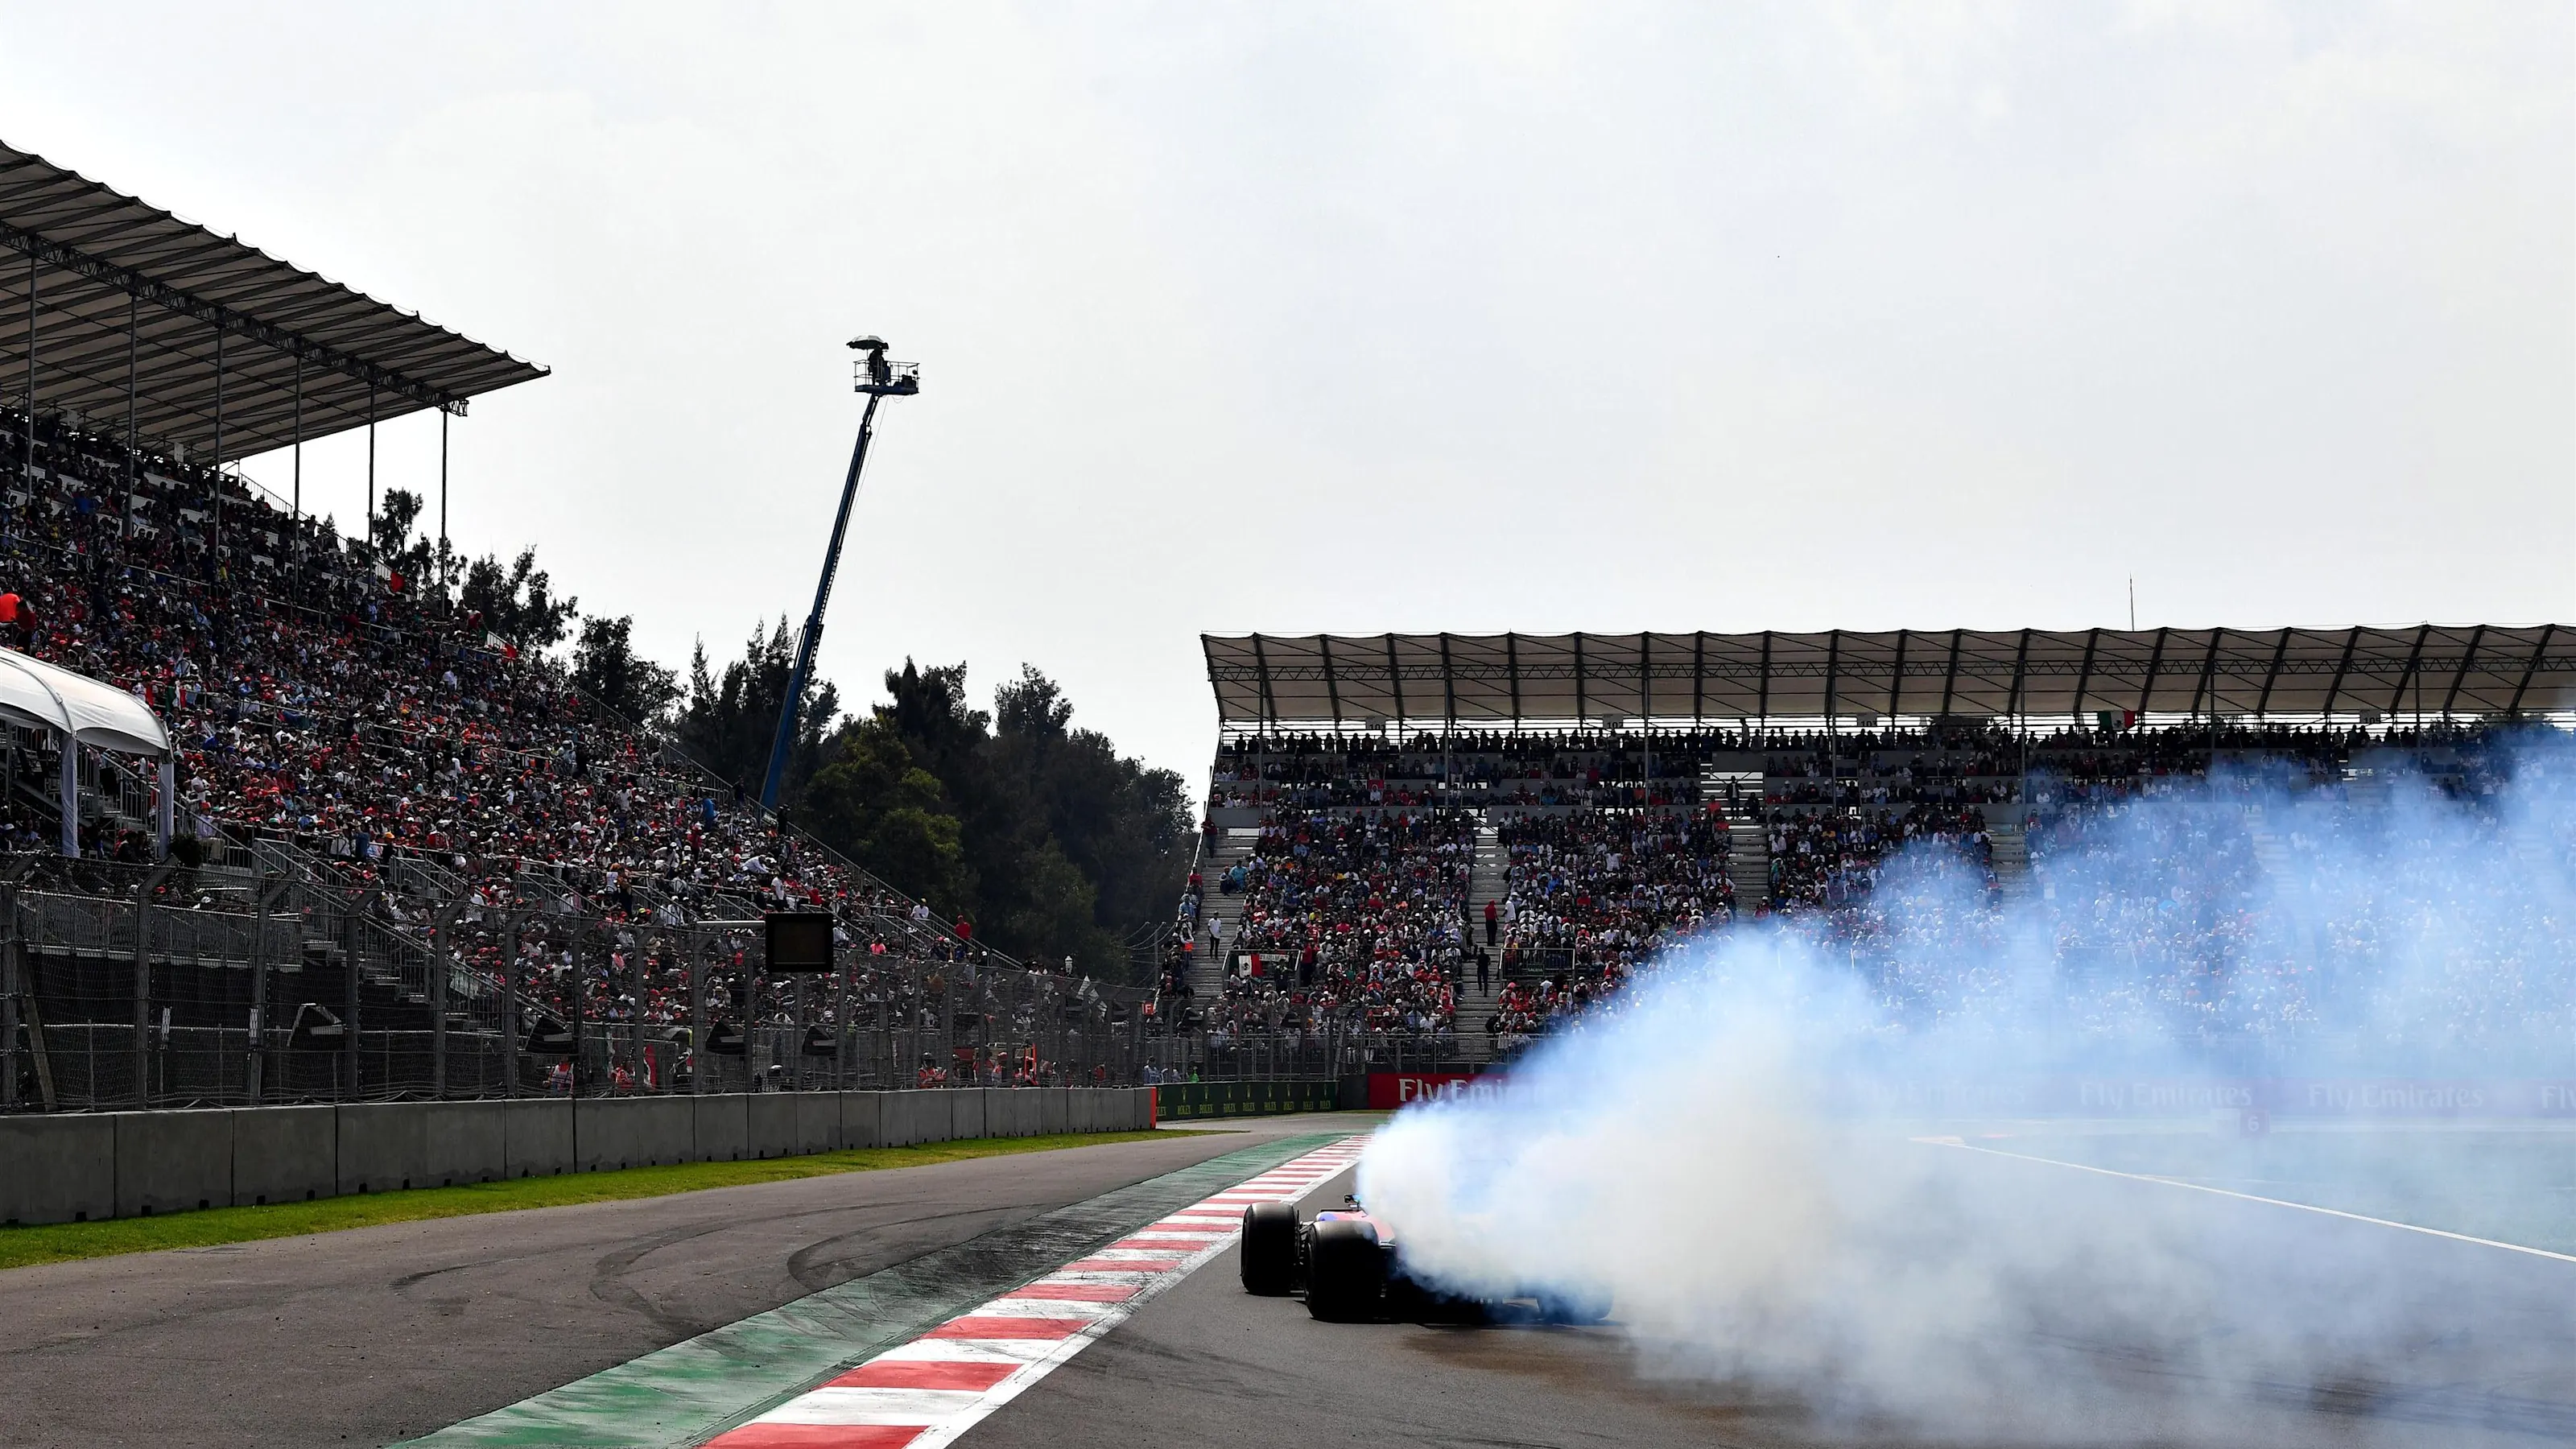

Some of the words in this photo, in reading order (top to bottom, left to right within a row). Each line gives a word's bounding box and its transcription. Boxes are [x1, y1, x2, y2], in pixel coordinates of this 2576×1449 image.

[1398, 1079, 1444, 1104] Fly
[2080, 1082, 2124, 1111] Fly
[2132, 1083, 2252, 1107] Emirates
[2308, 1084, 2354, 1112] Fly
[2362, 1083, 2485, 1108] Emirates
[2247, 1115, 2260, 1132] 6
